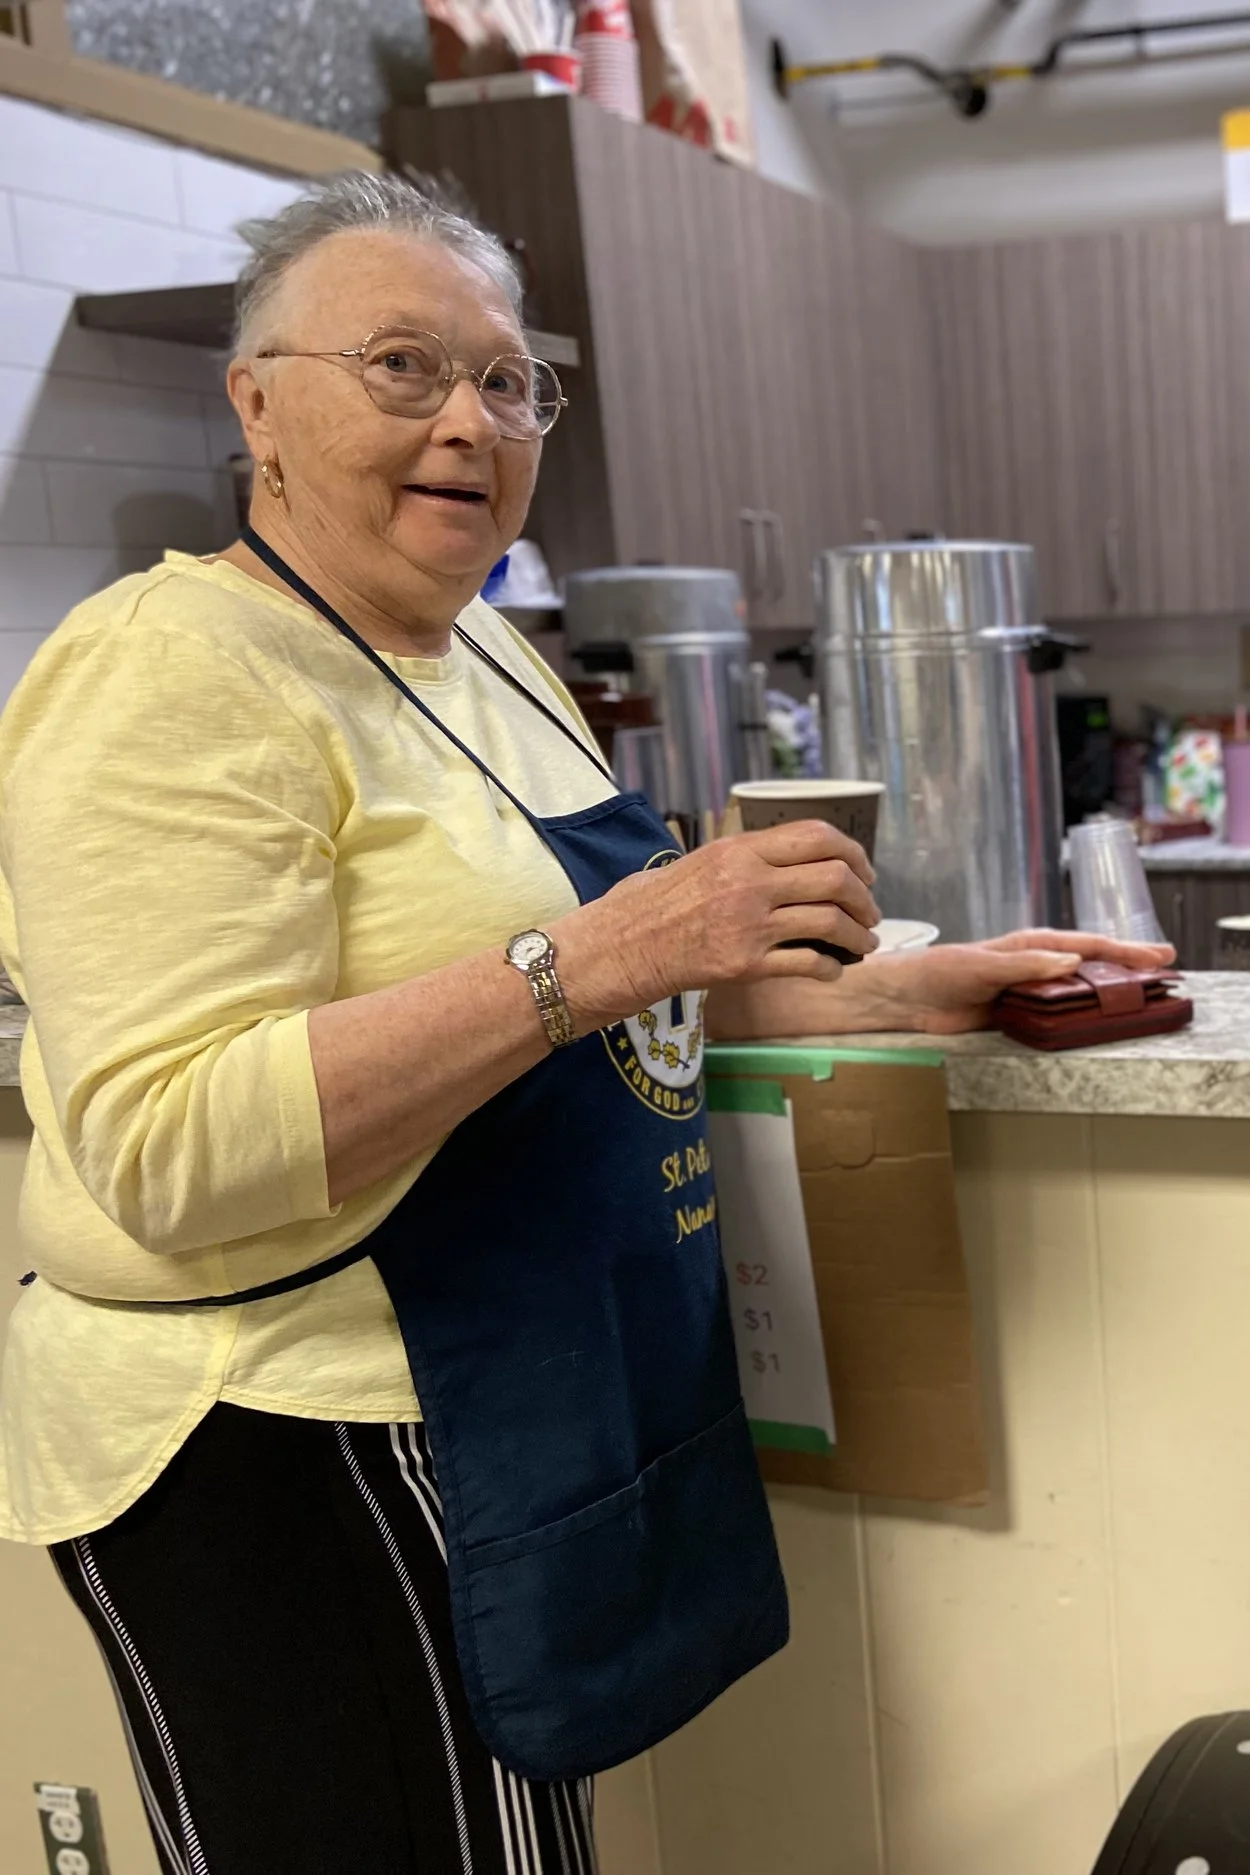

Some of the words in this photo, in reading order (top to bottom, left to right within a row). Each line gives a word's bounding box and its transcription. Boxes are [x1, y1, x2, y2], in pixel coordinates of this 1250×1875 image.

[624, 1055, 652, 1097] FOR
[653, 1087, 681, 1112] GOD
[736, 1260, 769, 1287] $2
[743, 1308, 773, 1332] $1
[750, 1350, 781, 1374] $1
